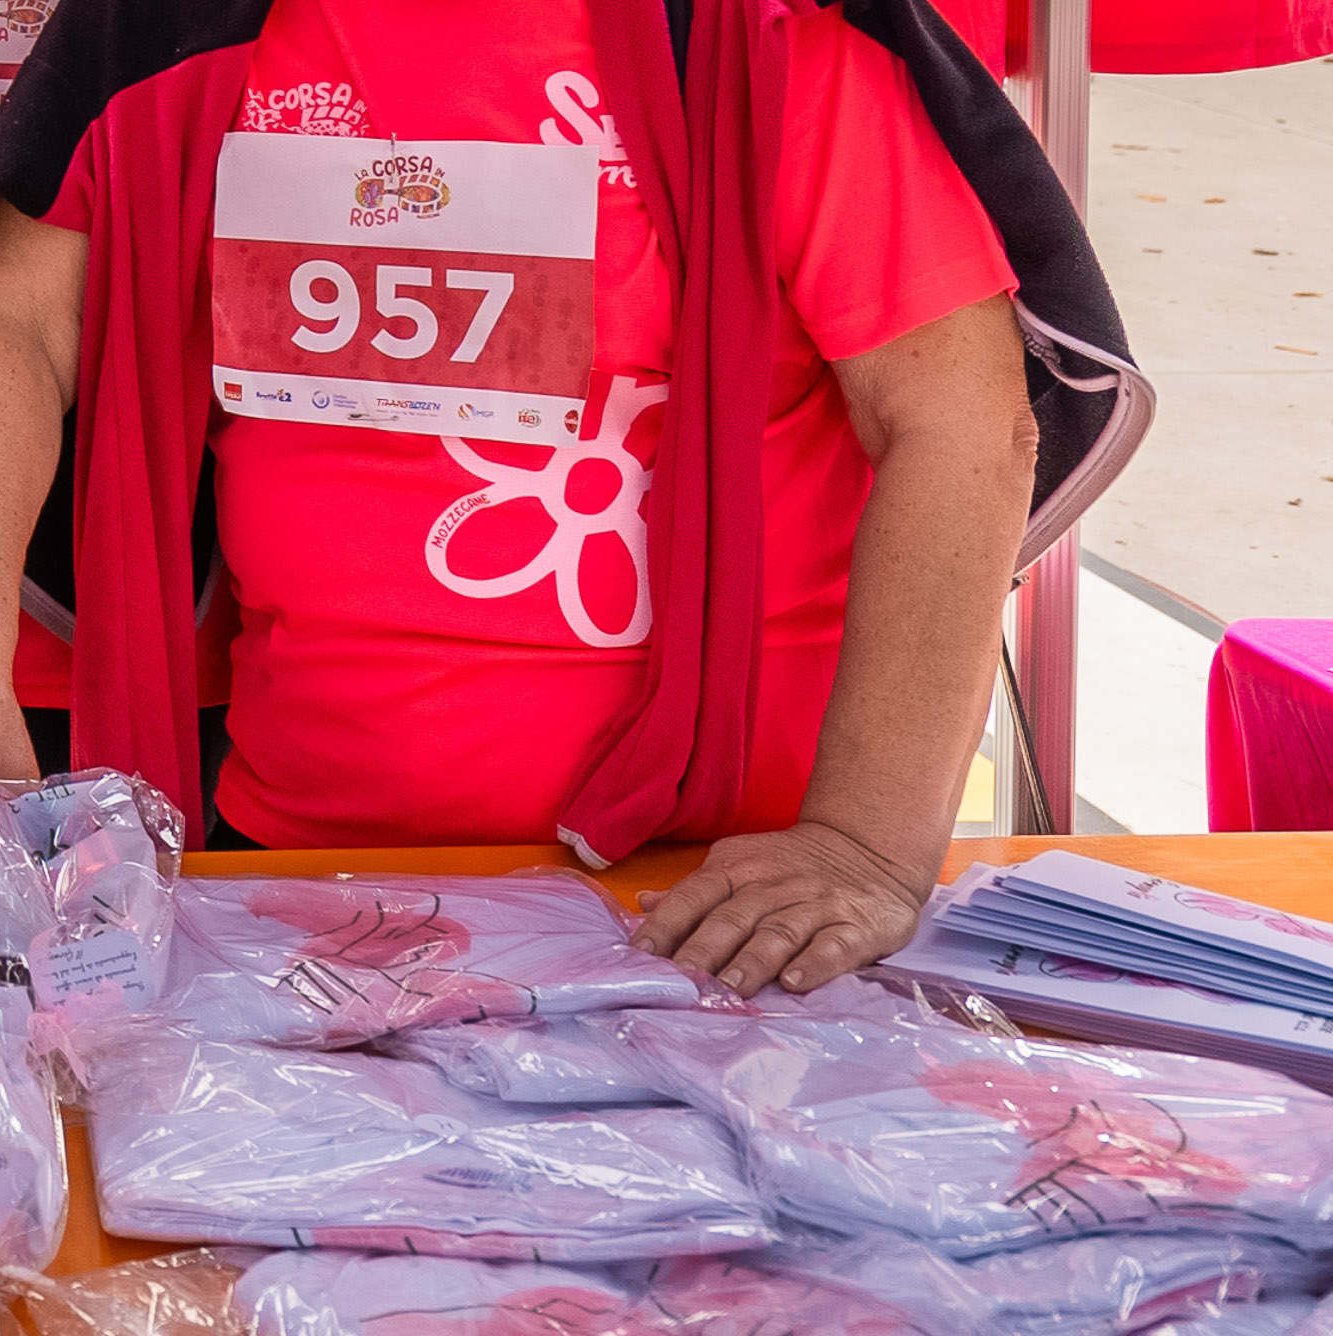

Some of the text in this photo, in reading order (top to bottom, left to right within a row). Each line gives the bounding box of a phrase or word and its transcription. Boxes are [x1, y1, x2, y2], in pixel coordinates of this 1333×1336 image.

[268, 81, 352, 110] CORSA
[372, 155, 433, 177] CORSA
[349, 207, 400, 227] ROSA
[289, 259, 515, 363] 957
[431, 493, 491, 549] MOZZECANE
